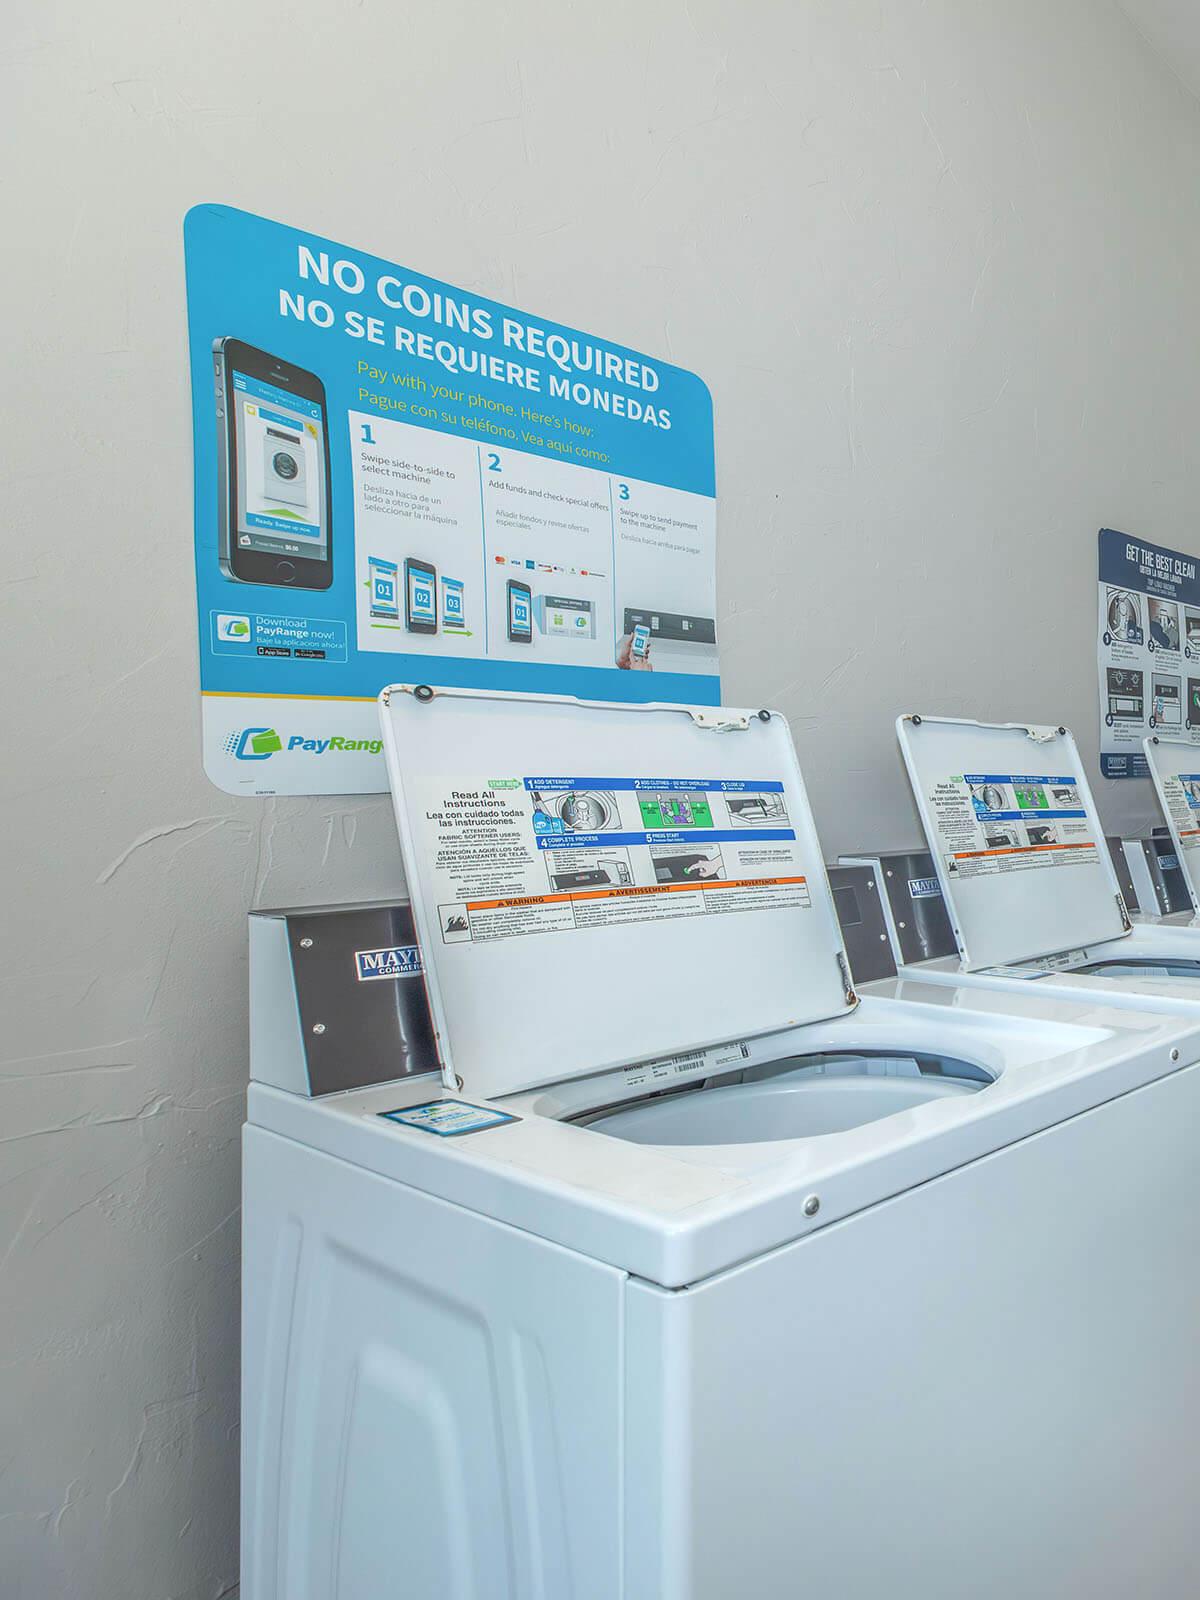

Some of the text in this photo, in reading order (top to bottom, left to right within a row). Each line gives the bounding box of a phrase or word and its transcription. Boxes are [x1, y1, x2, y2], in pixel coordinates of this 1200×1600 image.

[298, 245, 659, 392] NO COINS REQUIRED
[279, 289, 671, 430] NO SE REQUIERE MONEDAS
[357, 360, 388, 384] Pay
[392, 372, 427, 393] with
[431, 381, 465, 401] your
[469, 392, 517, 417] phone.
[564, 414, 595, 437] how:
[358, 388, 407, 411] Pague
[410, 402, 438, 419] con
[441, 410, 457, 425] su
[461, 413, 519, 441] teléfono.
[522, 430, 544, 446] Vea
[575, 446, 610, 463] como:
[360, 424, 376, 444] 1
[361, 452, 456, 479] Swipe side-to-side to
[487, 453, 502, 472] 2
[361, 464, 431, 485] select machine
[363, 483, 394, 496] Desliza
[419, 494, 430, 502] de
[488, 479, 609, 512] Add funds and check special offers
[618, 483, 630, 500] 3
[363, 493, 383, 503] lado
[392, 499, 410, 508] otro
[619, 508, 640, 519] Swipe
[640, 513, 649, 521] up
[657, 515, 672, 525] send
[672, 519, 698, 531] payment
[620, 517, 628, 525] to
[628, 518, 640, 527] the
[1126, 543, 1196, 580] GET THE BEST CLEAN
[377, 584, 391, 596] 01
[416, 592, 429, 603] 02
[448, 598, 459, 608] 03
[516, 609, 526, 617] 01
[256, 616, 307, 628] Download
[256, 626, 335, 640] PayRange now!
[288, 736, 383, 754] PayRang
[528, 780, 534, 789] 1
[634, 780, 641, 789] 2
[720, 782, 727, 791] 3
[451, 791, 495, 799] Read All
[444, 800, 506, 808] Instructions
[464, 810, 499, 818] cuidado
[501, 809, 525, 817] todas
[439, 818, 516, 827] las instrucciones.
[541, 838, 548, 847] 4
[646, 834, 653, 843] 5
[506, 896, 545, 906] WARNING
